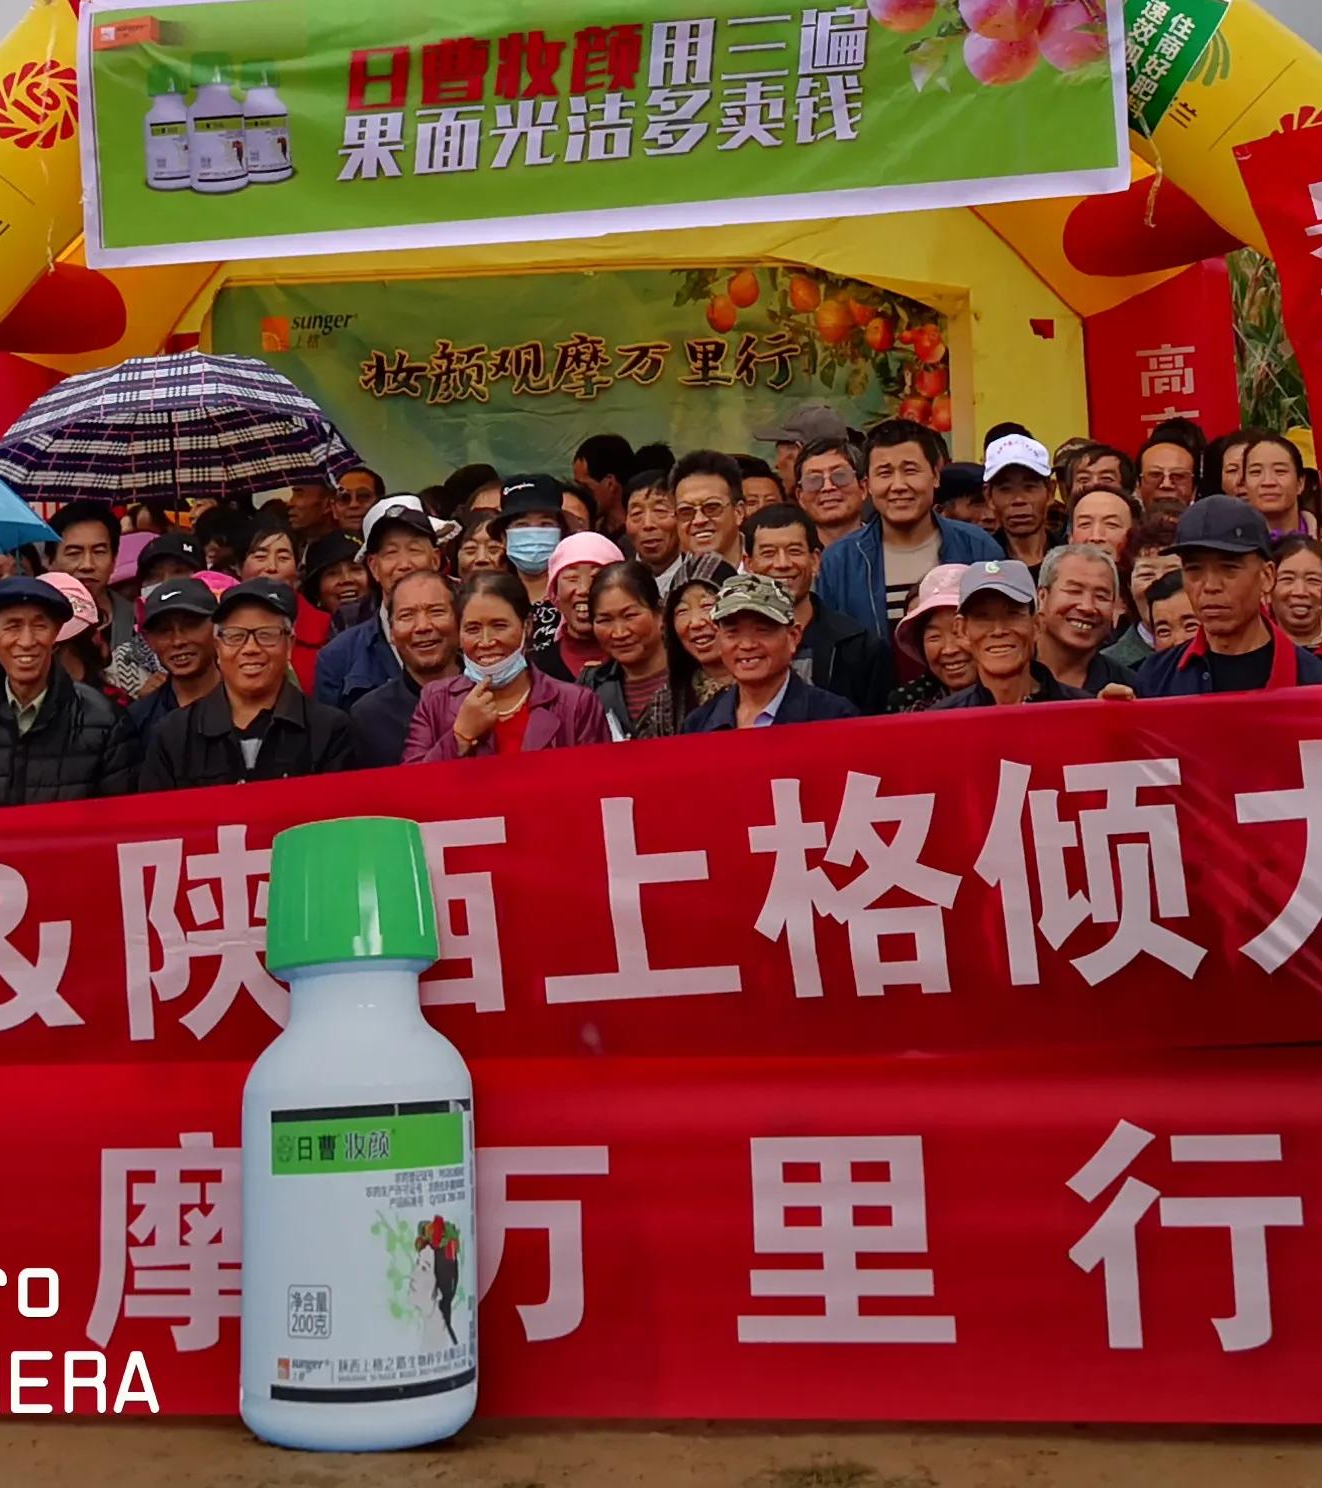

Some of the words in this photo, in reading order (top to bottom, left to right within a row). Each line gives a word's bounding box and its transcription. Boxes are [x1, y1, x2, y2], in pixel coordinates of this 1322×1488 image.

[345, 5, 870, 111] 日曹妆颜用三遍
[335, 73, 864, 182] 果面光洁多卖钱
[359, 332, 805, 405] 妆颜观摩万里行
[291, 1291, 327, 1313] 净含量
[291, 1313, 328, 1336] 200克
